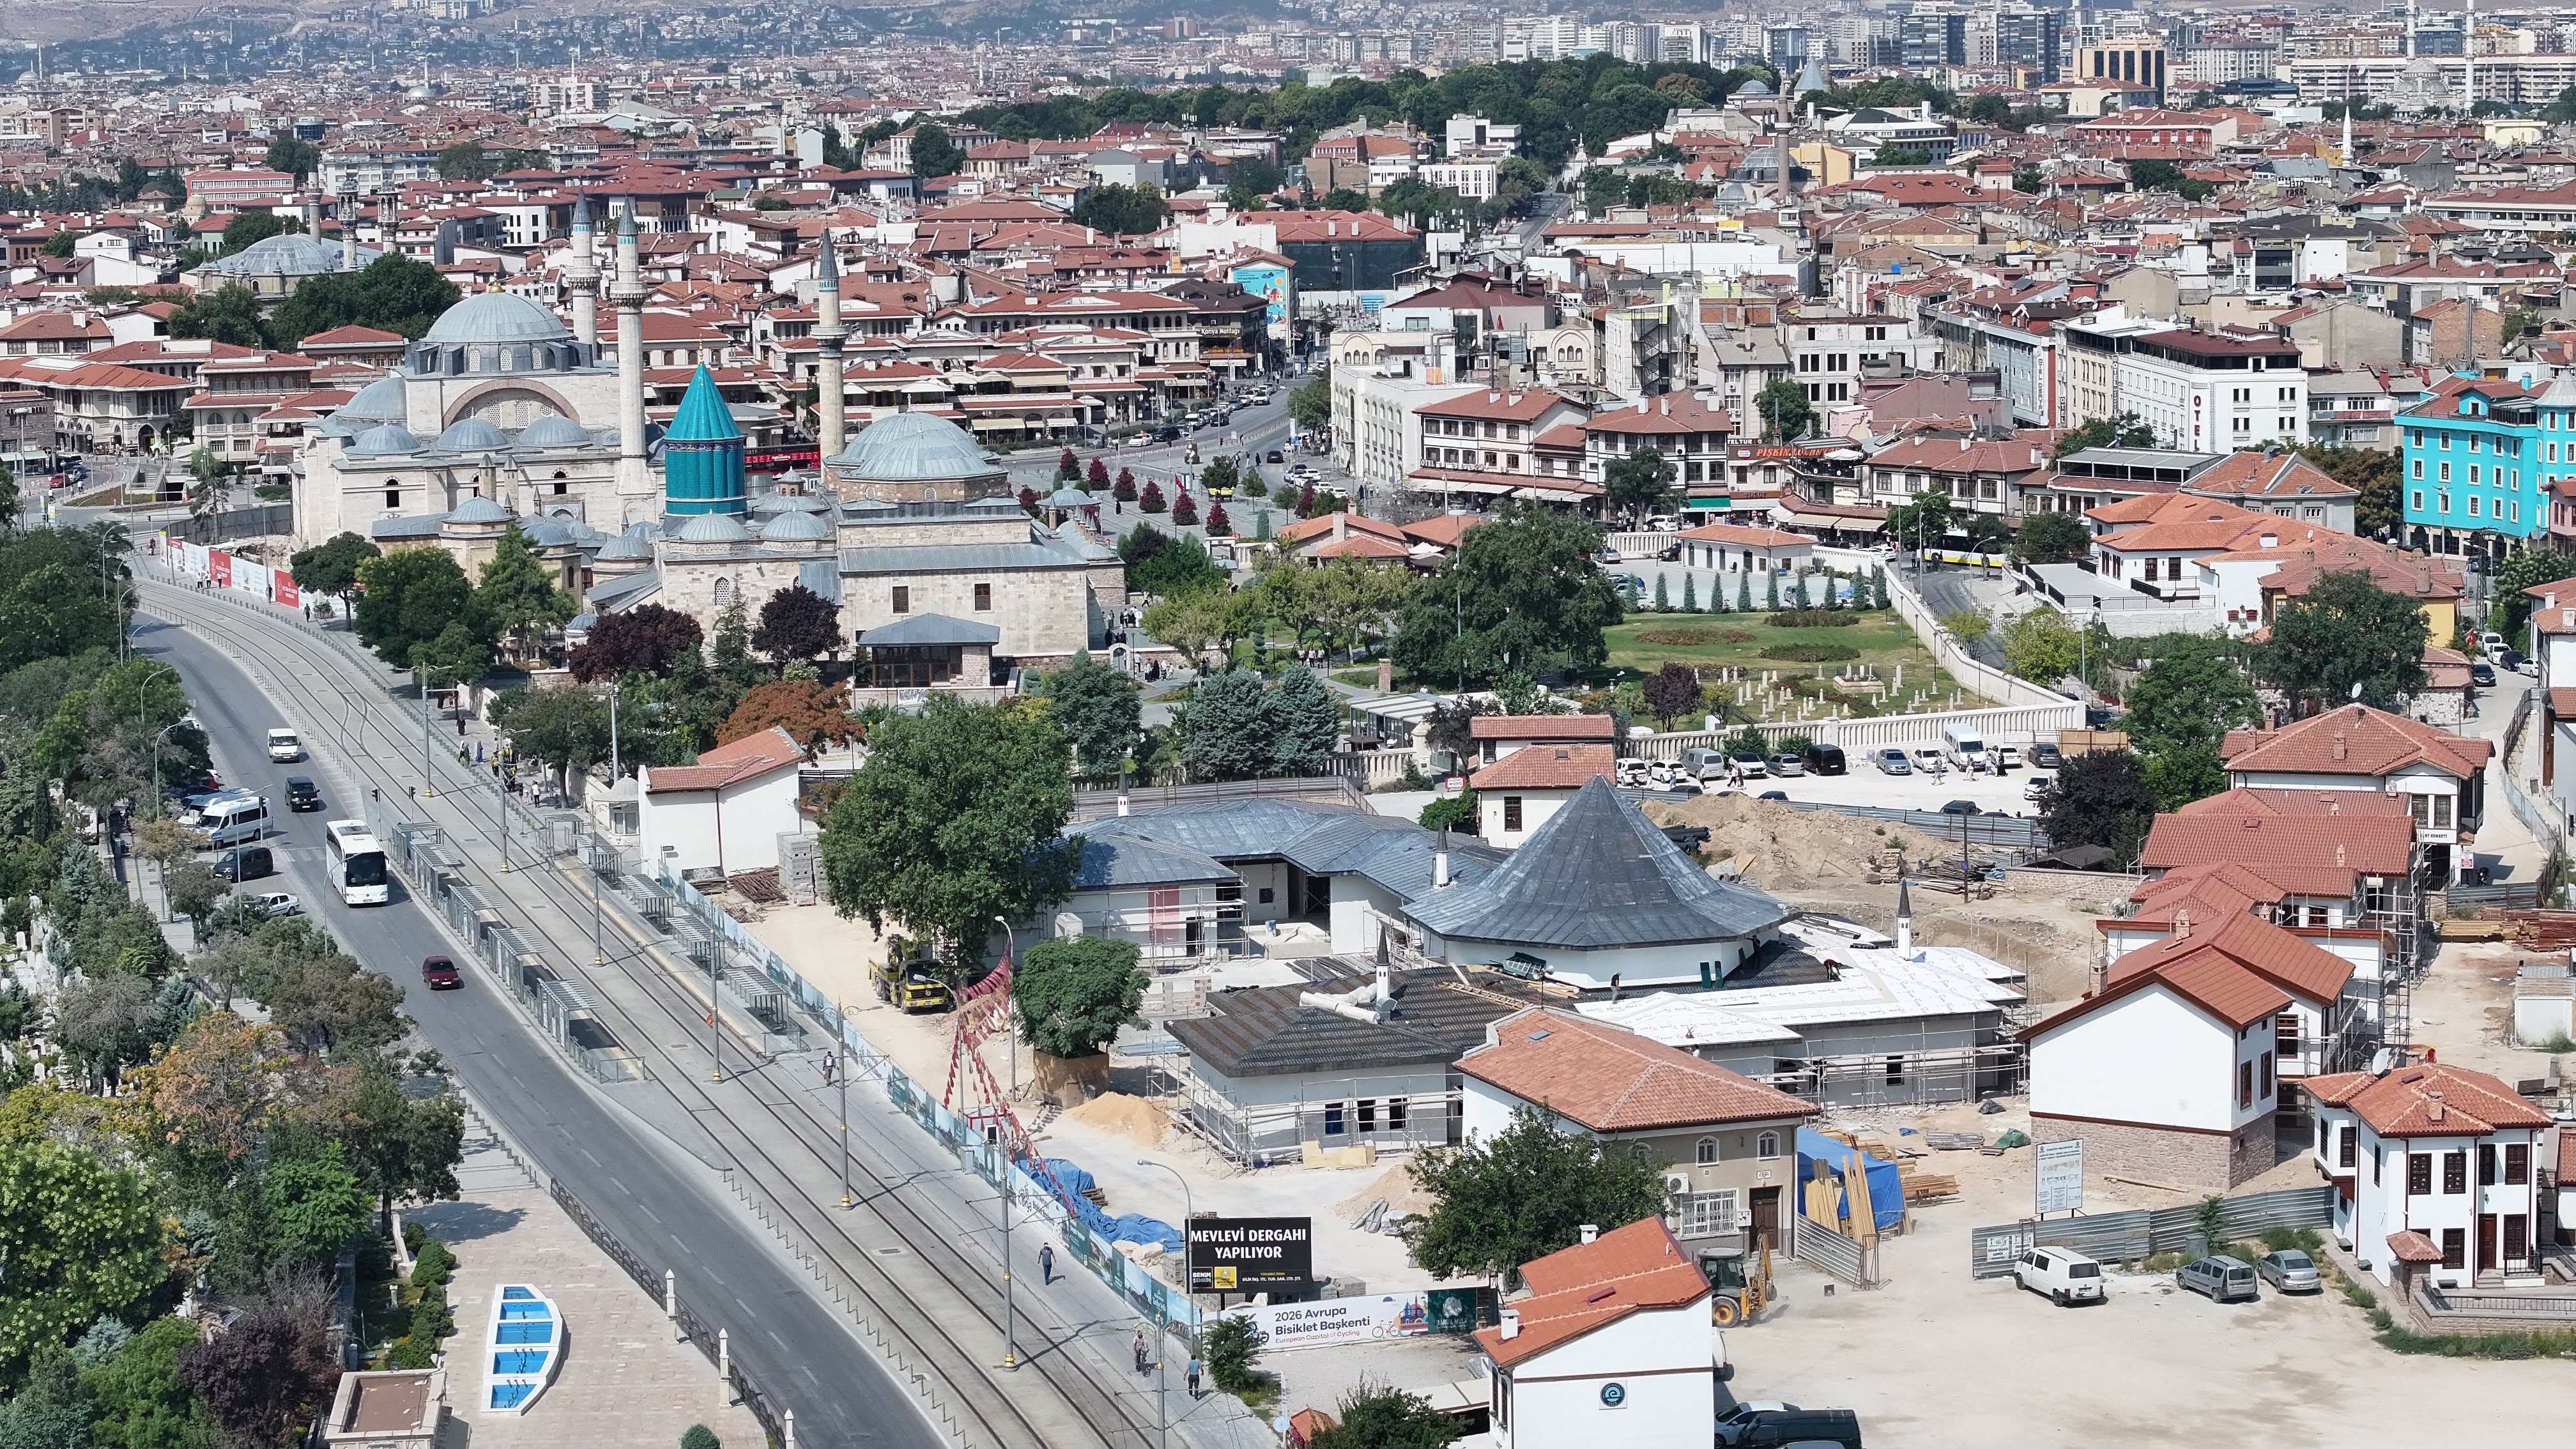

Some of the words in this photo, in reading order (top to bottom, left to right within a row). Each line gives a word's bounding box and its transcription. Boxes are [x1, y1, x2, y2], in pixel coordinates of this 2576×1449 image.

[1191, 1227, 1245, 1242] MEVLEVİ
[1248, 1229, 1307, 1241] DERGAHI
[1215, 1246, 1282, 1259] YAPILIYOR
[1275, 1310, 1302, 1322] 2026
[1305, 1307, 1347, 1319] Avrupa
[1275, 1322, 1318, 1335] Bisiklet
[1320, 1316, 1370, 1331] Başkenti
[1275, 1335, 1305, 1344] European
[1306, 1332, 1329, 1340] Capital
